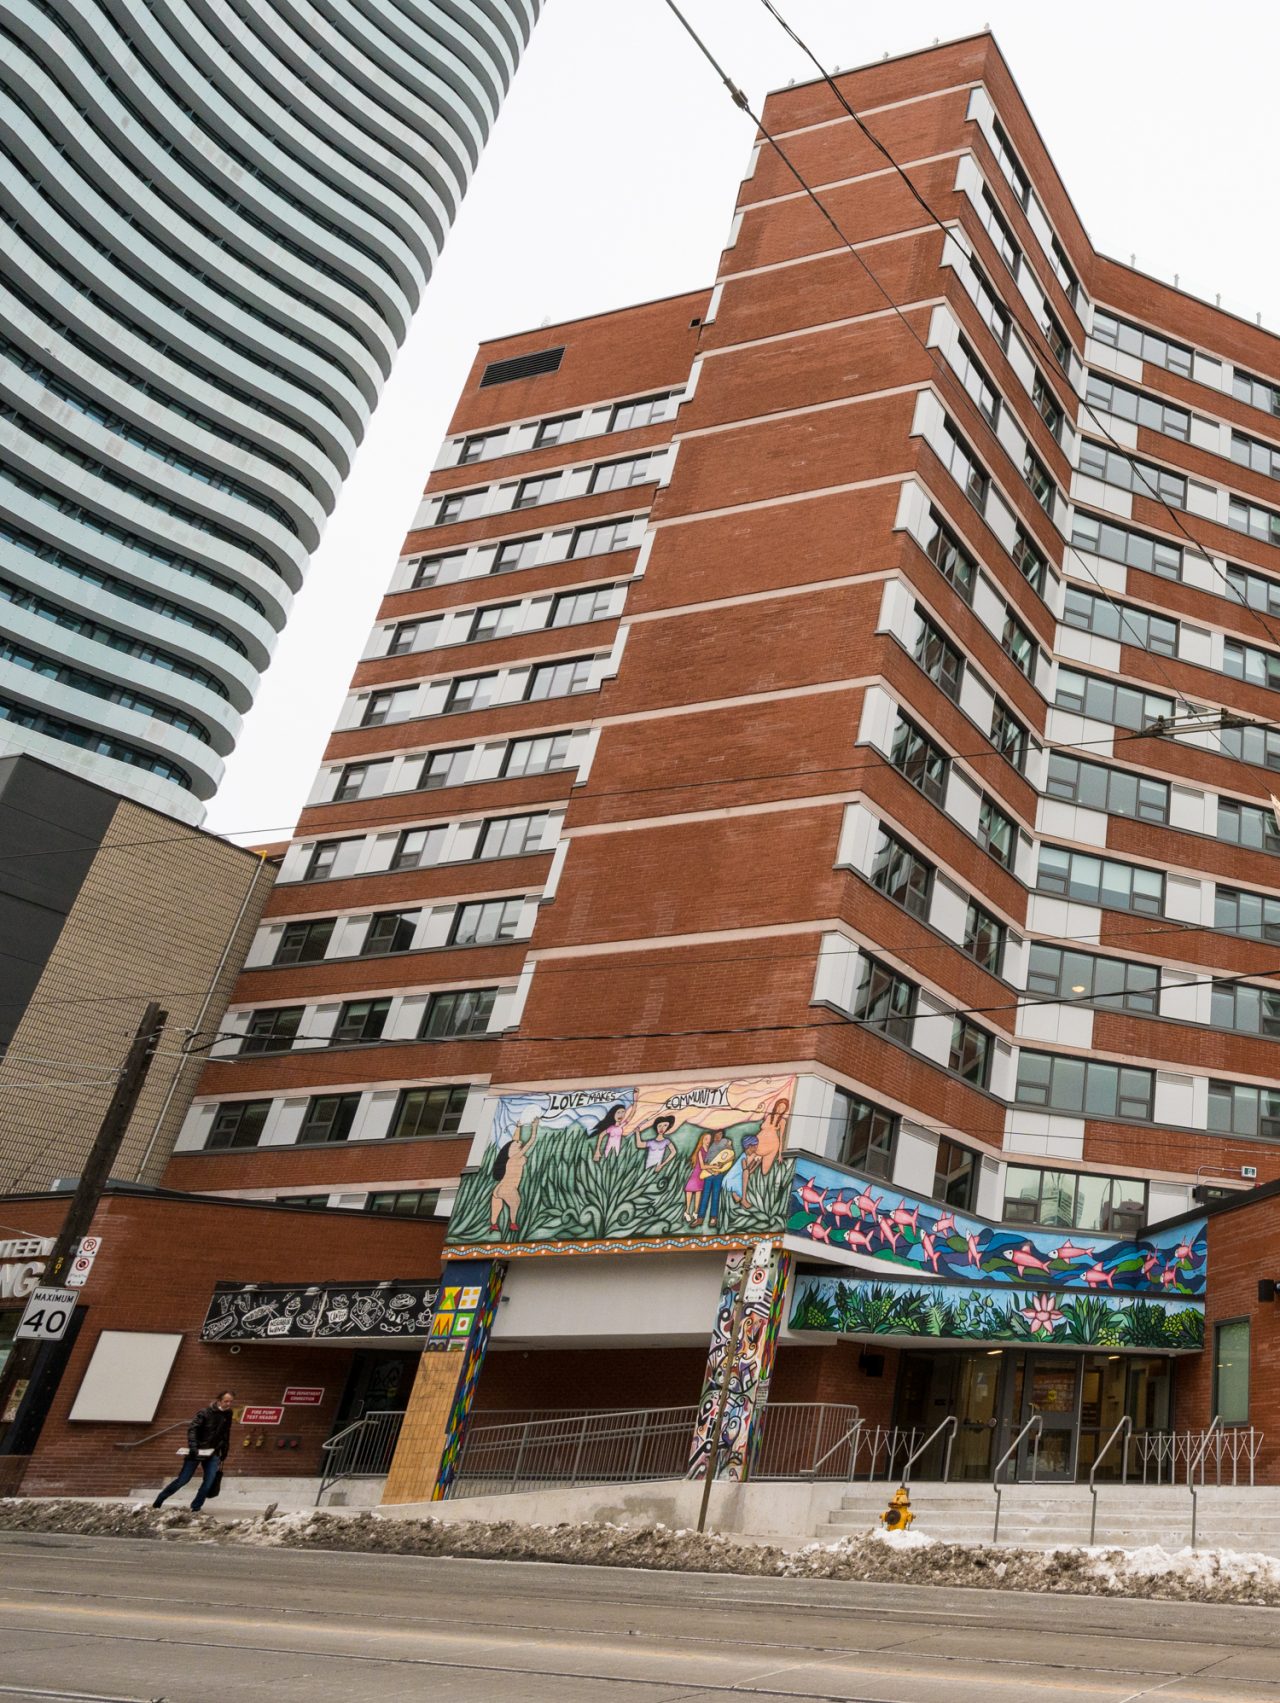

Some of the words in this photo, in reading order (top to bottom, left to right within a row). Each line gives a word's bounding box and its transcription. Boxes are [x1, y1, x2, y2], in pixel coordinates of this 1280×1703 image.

[550, 1094, 586, 1111] LOVE
[588, 1091, 616, 1102] MAKES
[665, 1088, 727, 1110] COMMUNITY
[33, 1292, 75, 1303] MAXIMUM
[22, 1309, 67, 1334] 40
